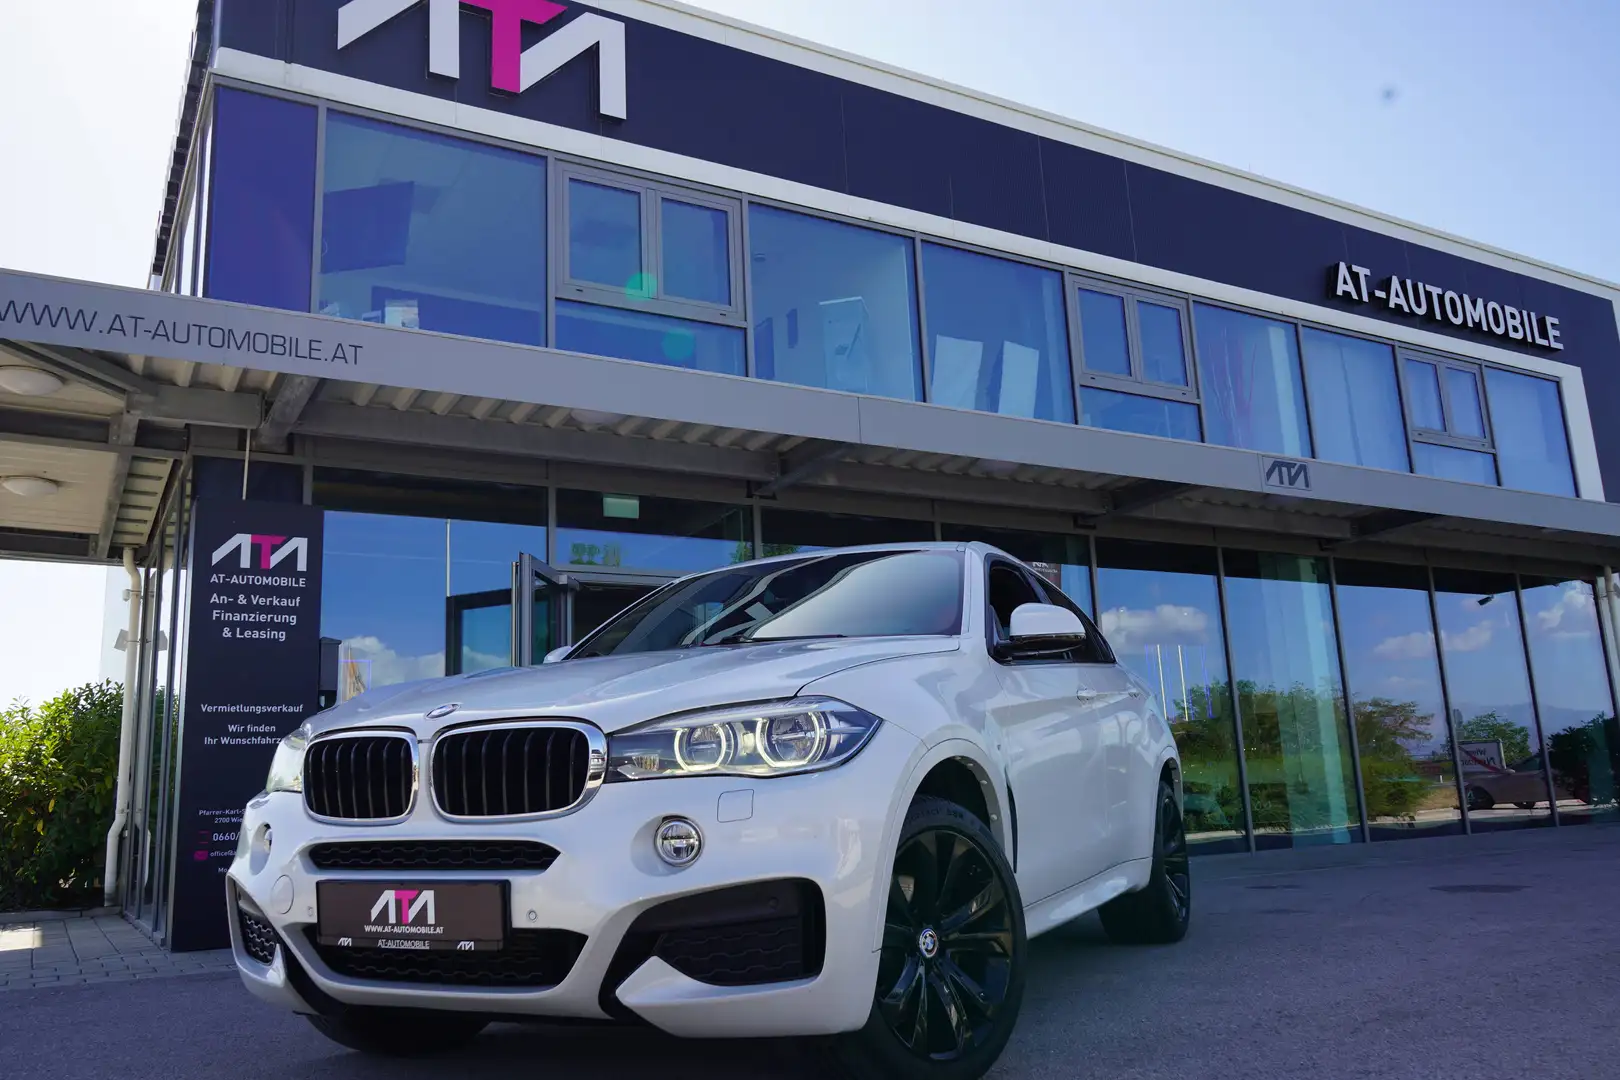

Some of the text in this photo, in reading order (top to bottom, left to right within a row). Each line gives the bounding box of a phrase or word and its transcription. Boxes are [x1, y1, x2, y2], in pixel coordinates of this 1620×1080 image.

[338, 0, 627, 120] ATA
[1335, 261, 1565, 350] AT-AUTOMOBILE
[0, 300, 363, 365] WWW.AT-AUTOMOBILE.AT
[1266, 460, 1309, 488] ATA
[211, 533, 308, 571] ATA
[210, 573, 306, 587] AT-AUTOMOBILE
[210, 593, 301, 607] An- & Verkauf
[212, 610, 297, 625] Finanzierung
[222, 627, 286, 641] & Leasing
[228, 724, 276, 733] Wir finden
[204, 737, 218, 745] Ihr
[371, 890, 435, 924] ATA
[364, 925, 444, 935] WWW.AT-AUTOMOBILE.AT
[378, 939, 430, 949] AT-AUTOMOBILE
[457, 941, 475, 951] ATA
